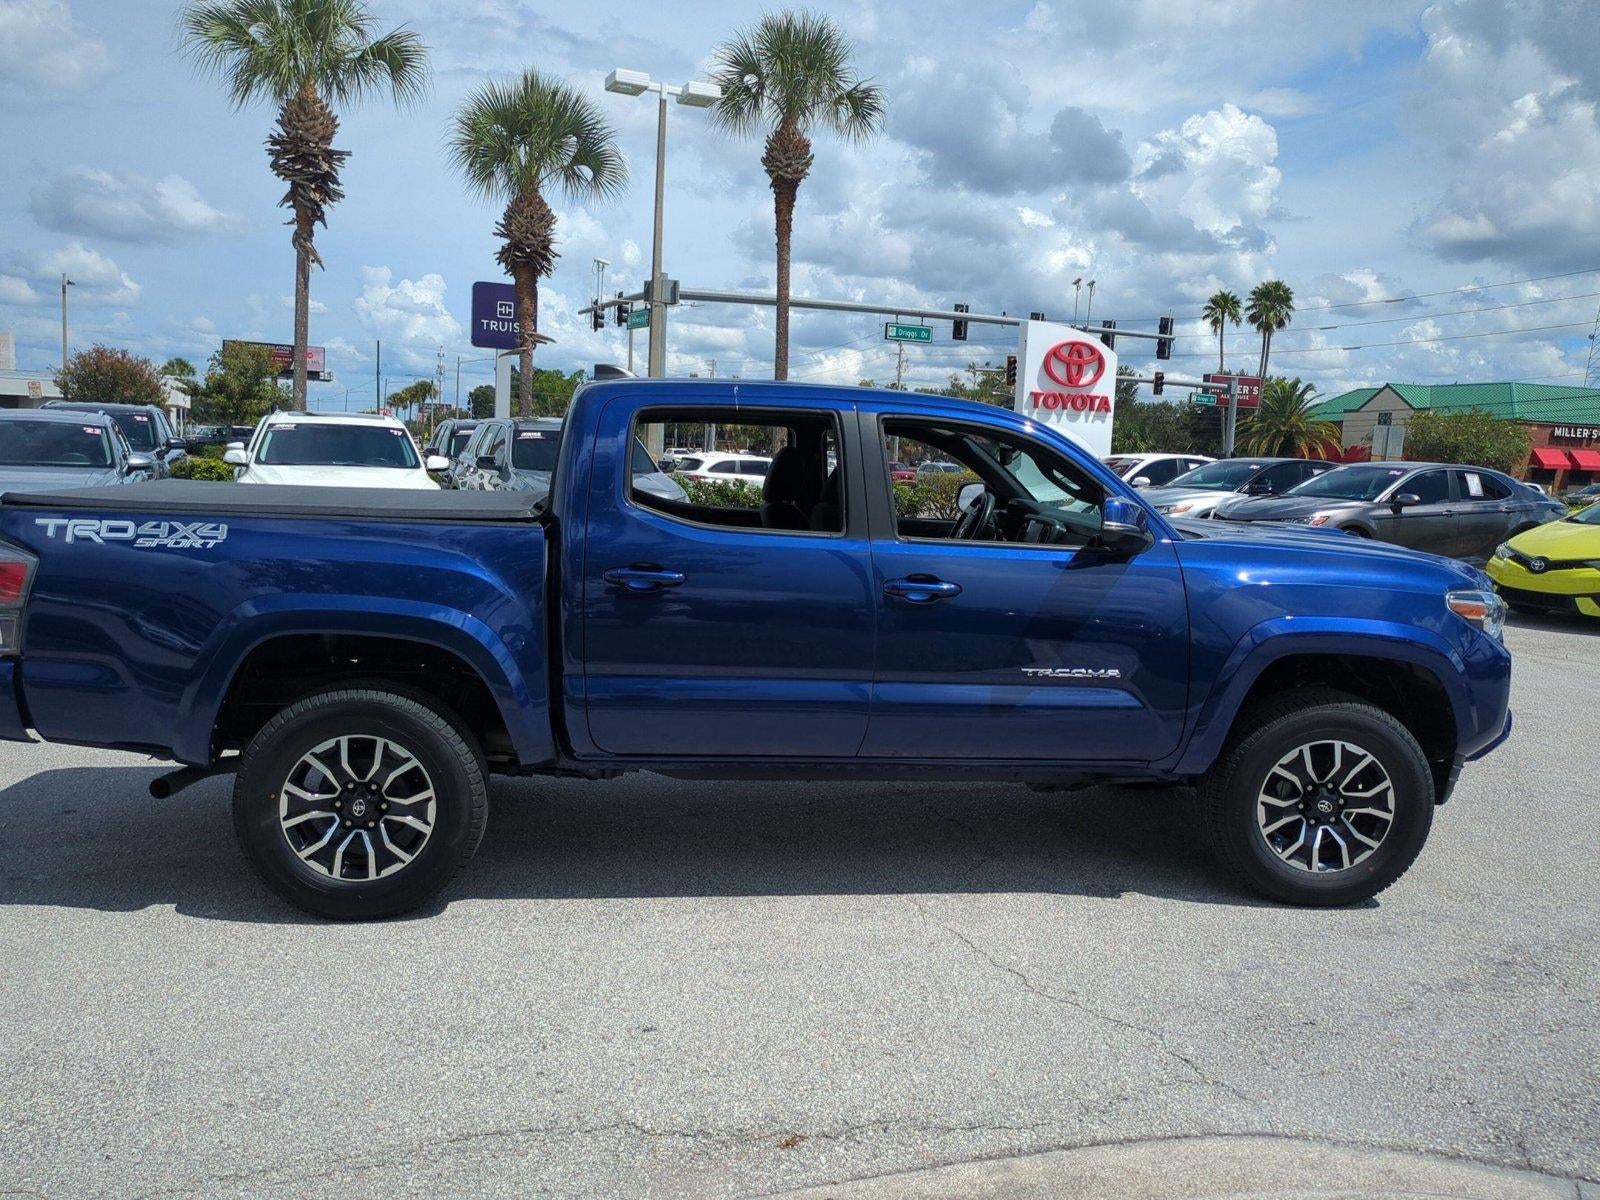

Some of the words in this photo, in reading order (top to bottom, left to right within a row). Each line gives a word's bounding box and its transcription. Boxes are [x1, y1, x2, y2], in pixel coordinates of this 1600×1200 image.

[481, 319, 521, 333] TRUIS
[898, 329, 918, 339] Driggs
[920, 330, 929, 338] Dr
[1030, 391, 1112, 413] TOYOTA
[1554, 426, 1598, 439] MILLER'S
[35, 518, 137, 545] TRD
[134, 537, 224, 549] SPORT
[1021, 668, 1121, 678] TACOMA
